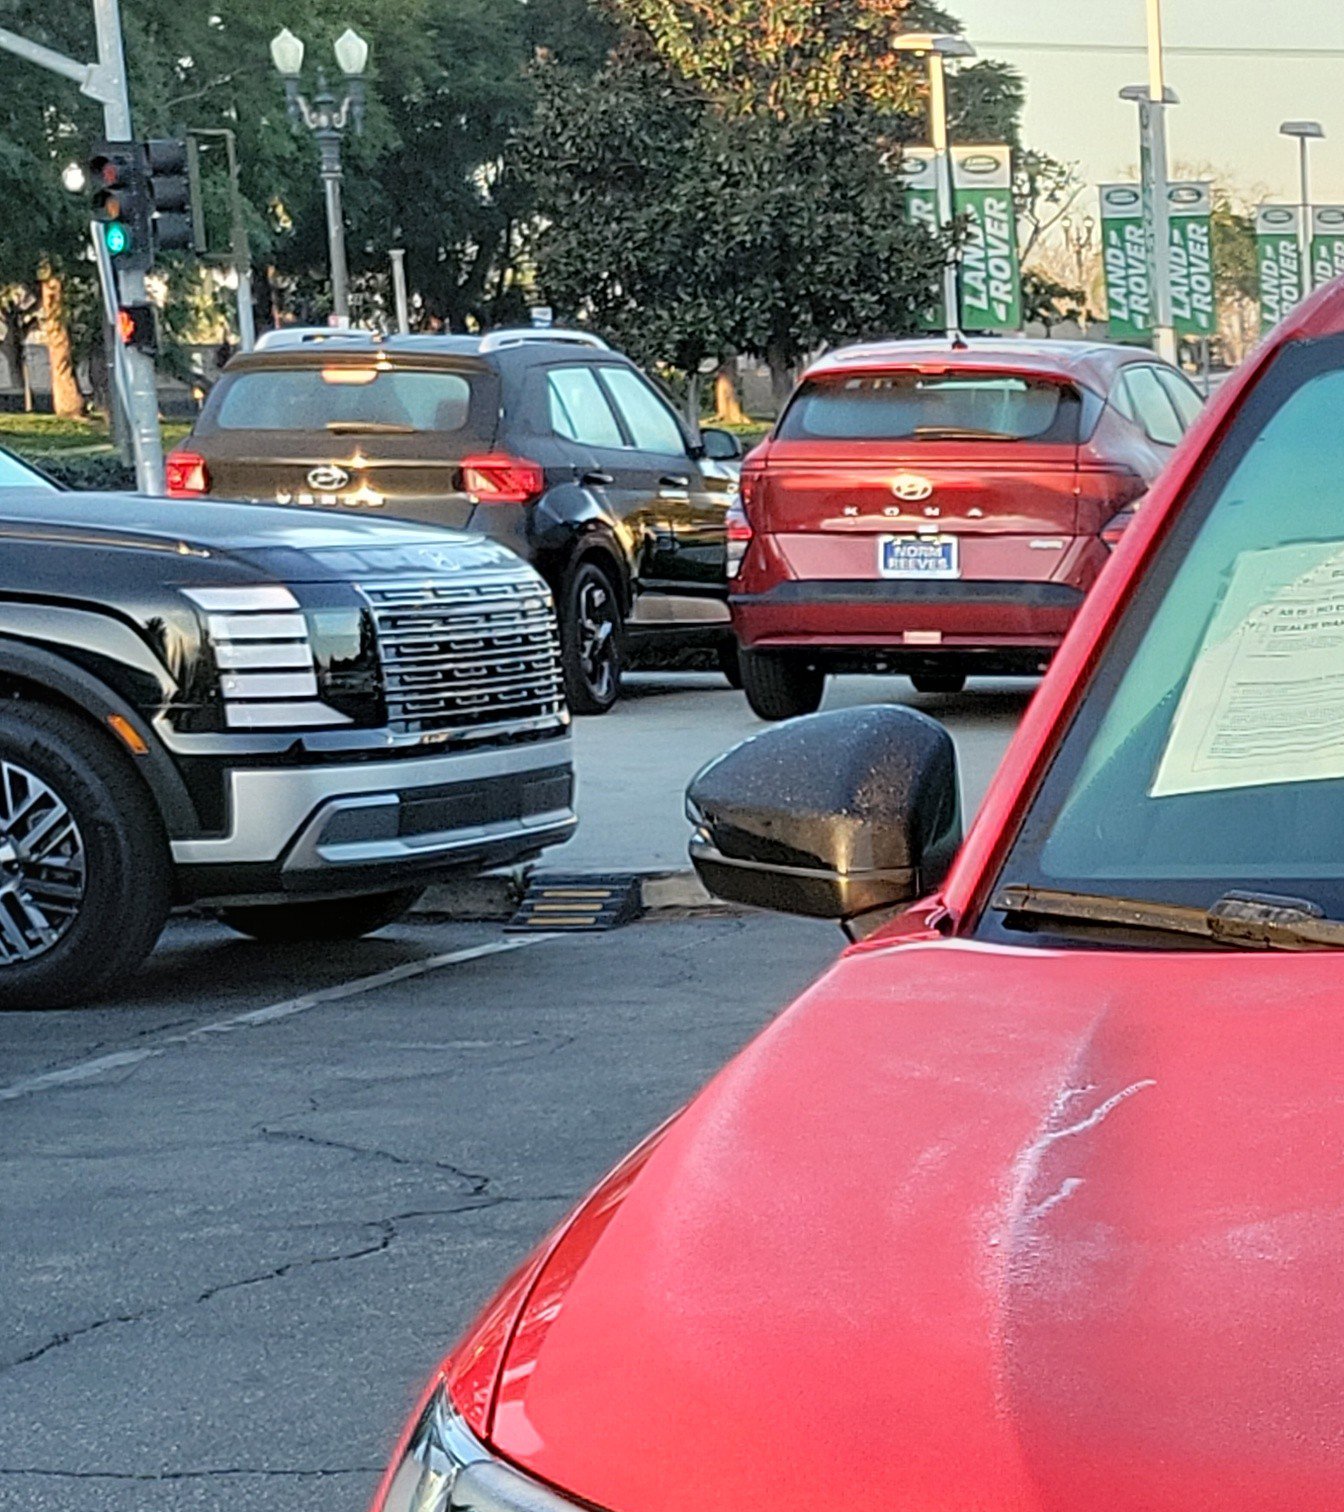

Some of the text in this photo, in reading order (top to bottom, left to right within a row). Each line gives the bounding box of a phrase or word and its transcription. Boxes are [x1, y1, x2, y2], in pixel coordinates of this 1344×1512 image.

[984, 197, 1012, 303] ROVER
[1106, 245, 1129, 321] LAND
[1125, 224, 1150, 315] ROVER
[1168, 245, 1191, 320] LAND
[1187, 222, 1212, 314] ROVER
[1261, 259, 1280, 322] LAND
[887, 557, 948, 570] REEVES
[893, 545, 943, 558] NORM
